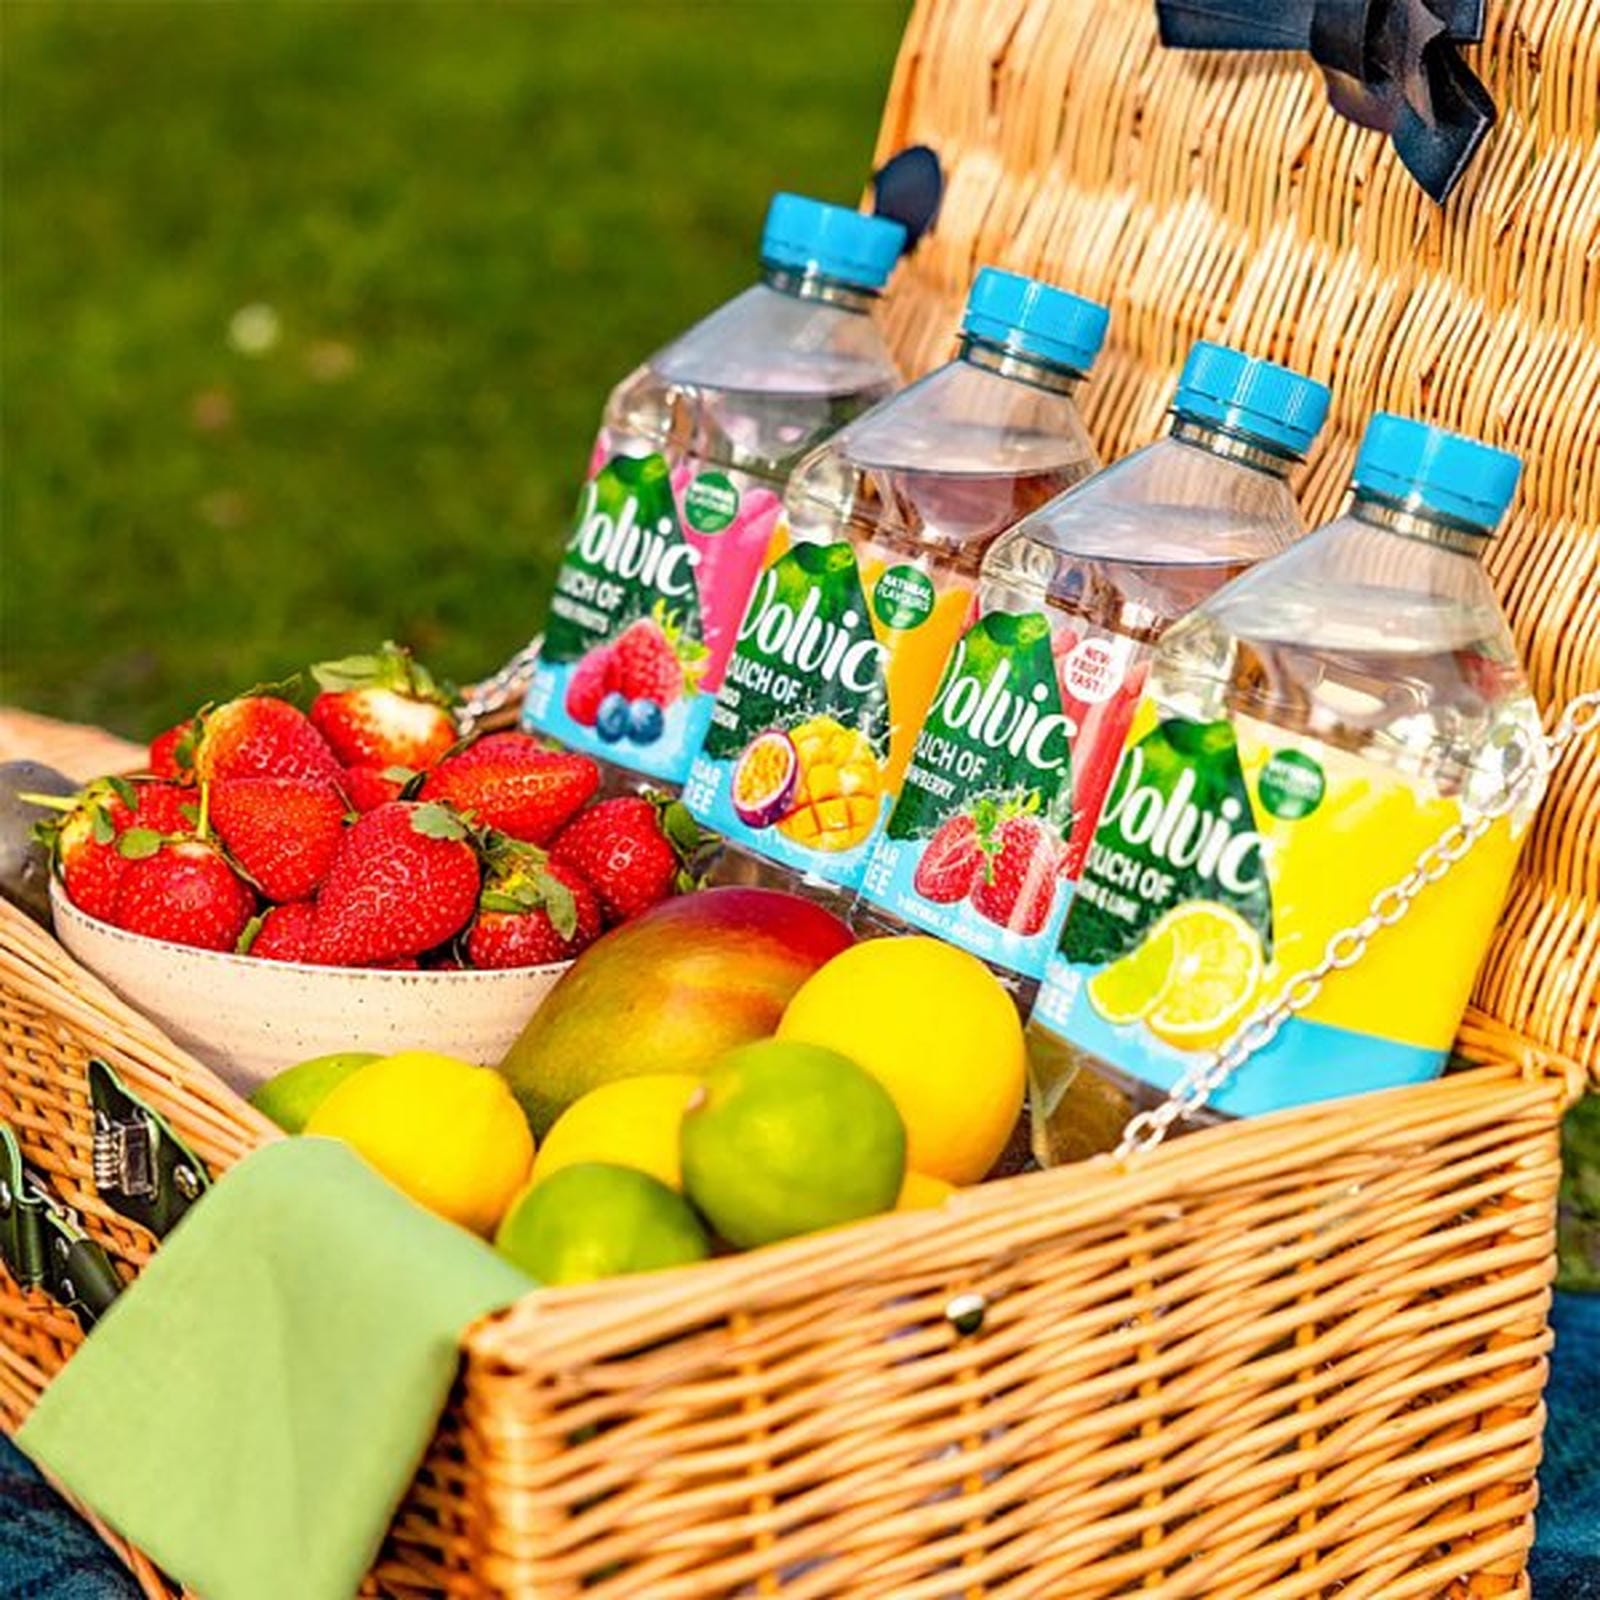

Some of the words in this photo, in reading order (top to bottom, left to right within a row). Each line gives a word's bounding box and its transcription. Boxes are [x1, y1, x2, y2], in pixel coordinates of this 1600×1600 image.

[771, 673, 802, 705] OF
[956, 751, 987, 782] OF
[1138, 868, 1176, 905] OF
